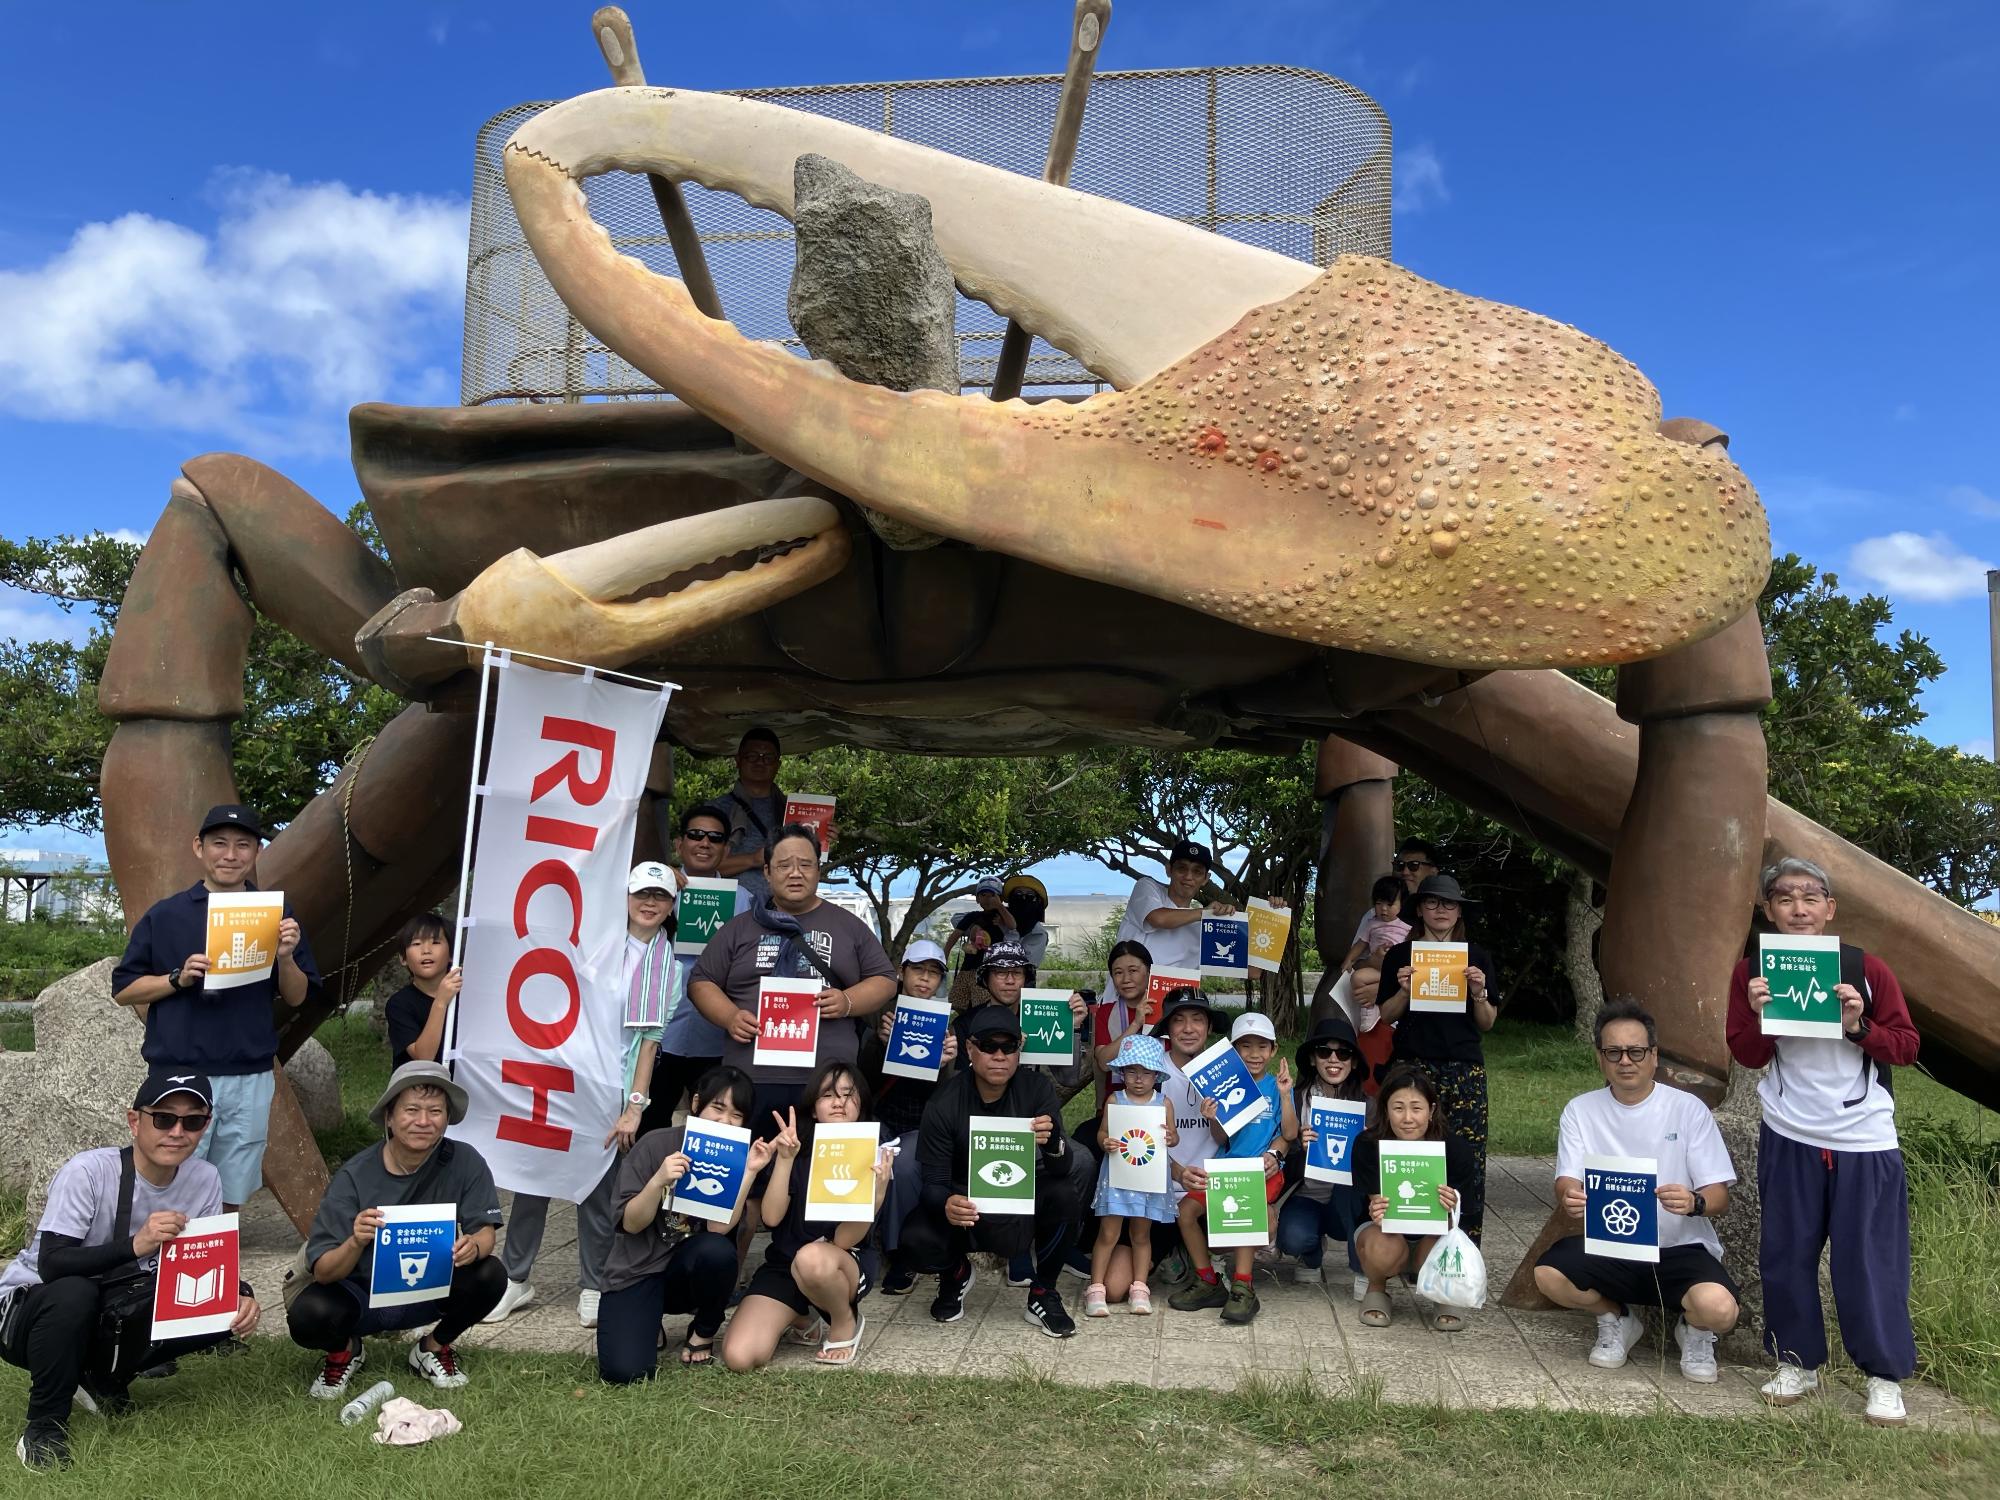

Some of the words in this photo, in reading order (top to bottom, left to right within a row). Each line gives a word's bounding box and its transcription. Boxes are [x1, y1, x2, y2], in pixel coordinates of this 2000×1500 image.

[789, 805, 795, 814] 5
[683, 892, 690, 904] 3
[212, 912, 224, 927] 11
[1204, 922, 1213, 932] 16
[496, 716, 616, 1152] RICOH
[1415, 952, 1424, 963] 11
[1766, 954, 1776, 969] 3
[1780, 963, 1817, 971] 健康と福祉を
[1152, 979, 1159, 990] 5
[763, 995, 770, 1008] 1
[1024, 1003, 1031, 1015] 3
[897, 1011, 909, 1024] 14
[1194, 1074, 1208, 1089] 14
[1314, 1113, 1321, 1126] 6
[687, 1136, 701, 1152] 14
[973, 1135, 987, 1150] 13
[818, 1143, 827, 1158] 2
[1384, 1160, 1397, 1174] 15
[1208, 1177, 1221, 1190] 15
[1588, 1174, 1601, 1190] 17
[381, 1228, 392, 1246] 6
[396, 1227, 444, 1237] 安全な水とトイレ
[396, 1236, 429, 1245] を世界中に
[166, 1244, 177, 1262] 4
[182, 1250, 209, 1260] みんなに
